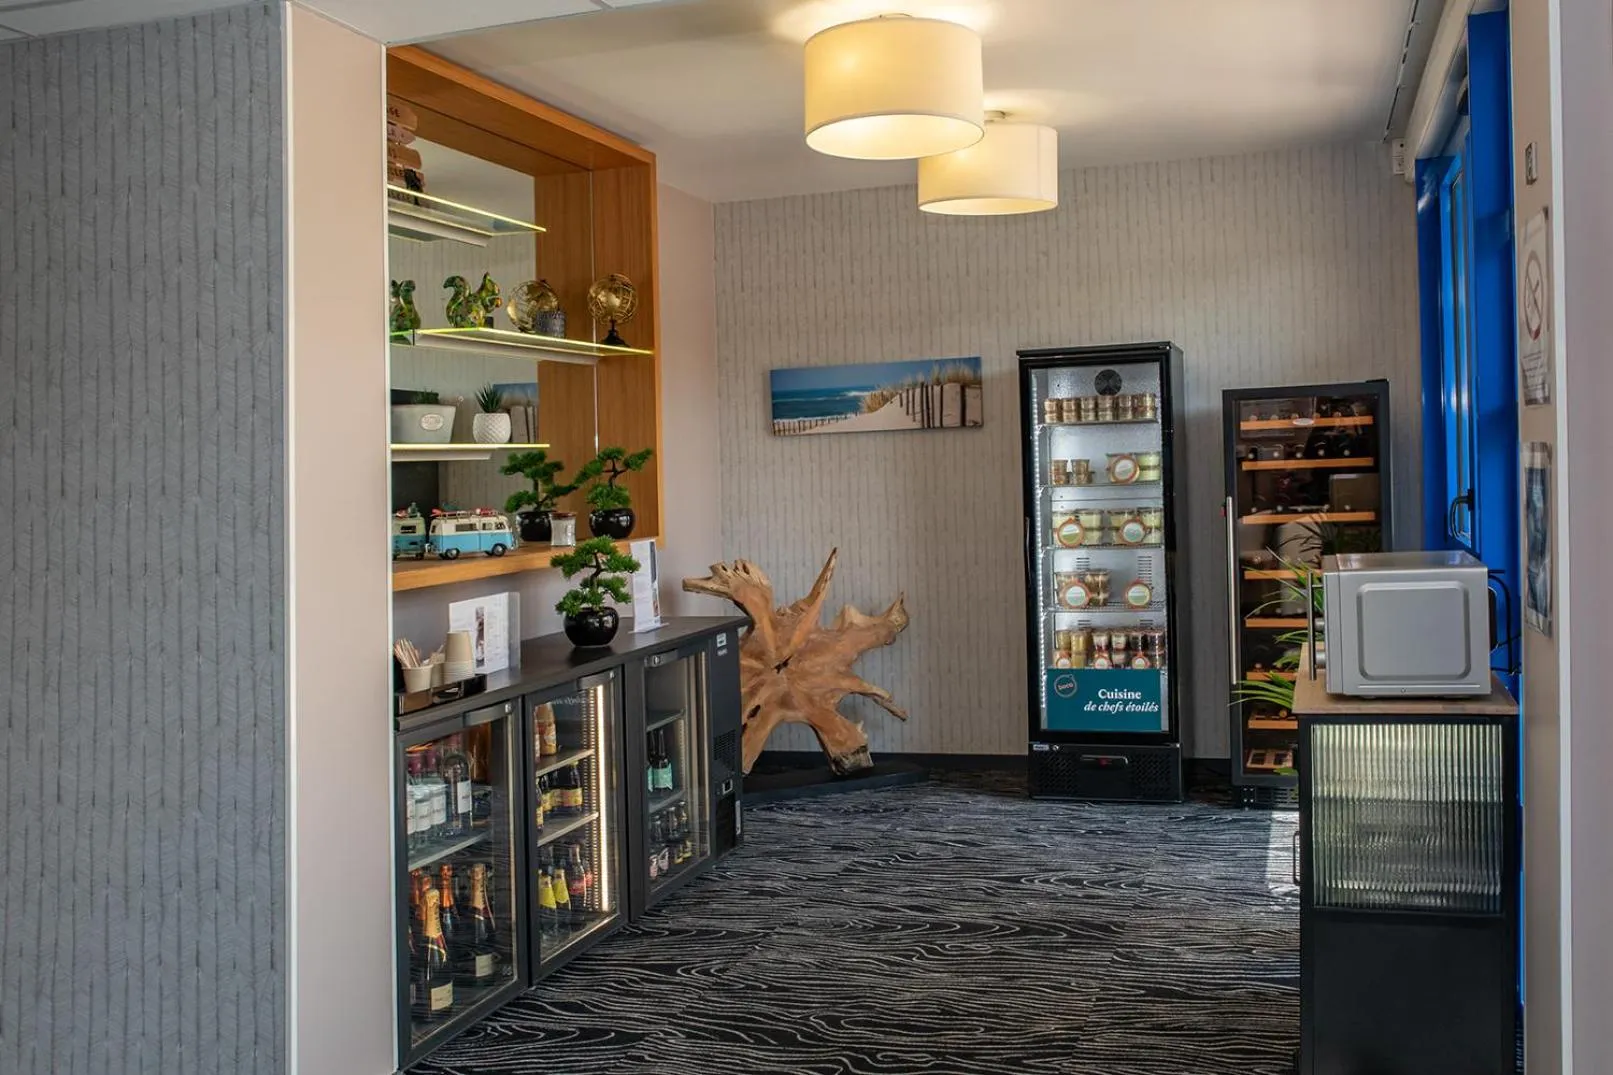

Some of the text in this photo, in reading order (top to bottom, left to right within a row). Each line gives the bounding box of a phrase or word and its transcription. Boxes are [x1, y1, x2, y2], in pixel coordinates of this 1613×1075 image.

[1098, 689, 1142, 699] Cuisine
[1084, 701, 1159, 714] de chefs étoilés
